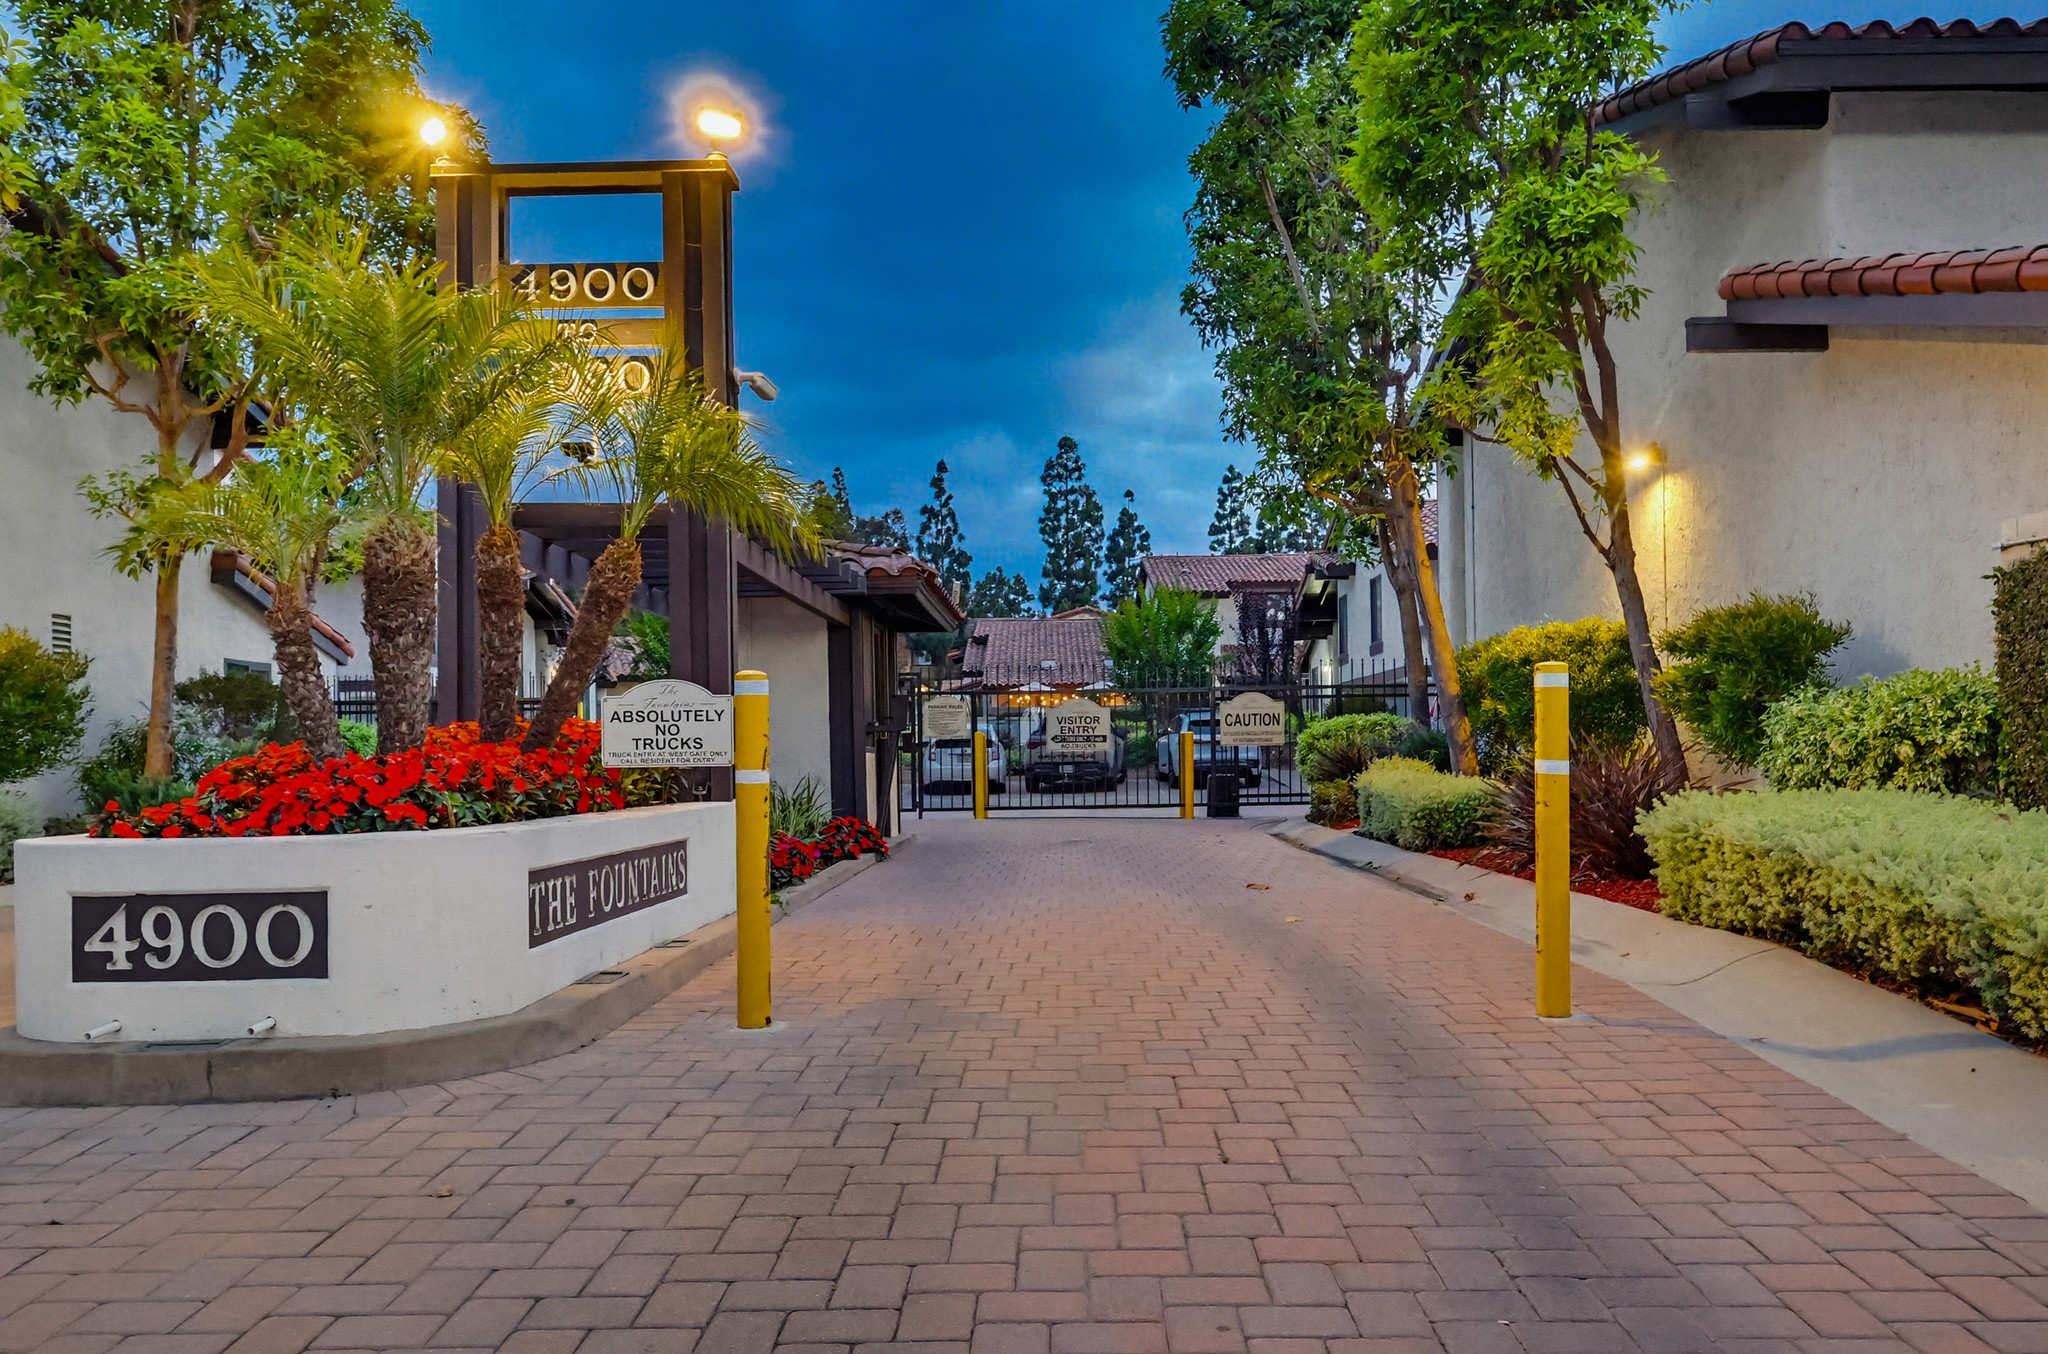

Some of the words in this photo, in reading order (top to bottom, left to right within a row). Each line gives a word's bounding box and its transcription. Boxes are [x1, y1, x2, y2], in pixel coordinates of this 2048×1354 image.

[511, 267, 655, 303] 4900
[658, 683, 679, 696] The
[610, 709, 725, 723] ABSOLUTELY
[1056, 715, 1101, 725] VISITOR
[1224, 712, 1281, 727] CAUTION
[655, 724, 680, 736] NO
[1060, 725, 1097, 735] ENTRY
[632, 737, 704, 750] TRUCKS
[529, 873, 577, 936] THE
[588, 849, 686, 918] FOUNTAINS
[83, 903, 315, 970] 4900
